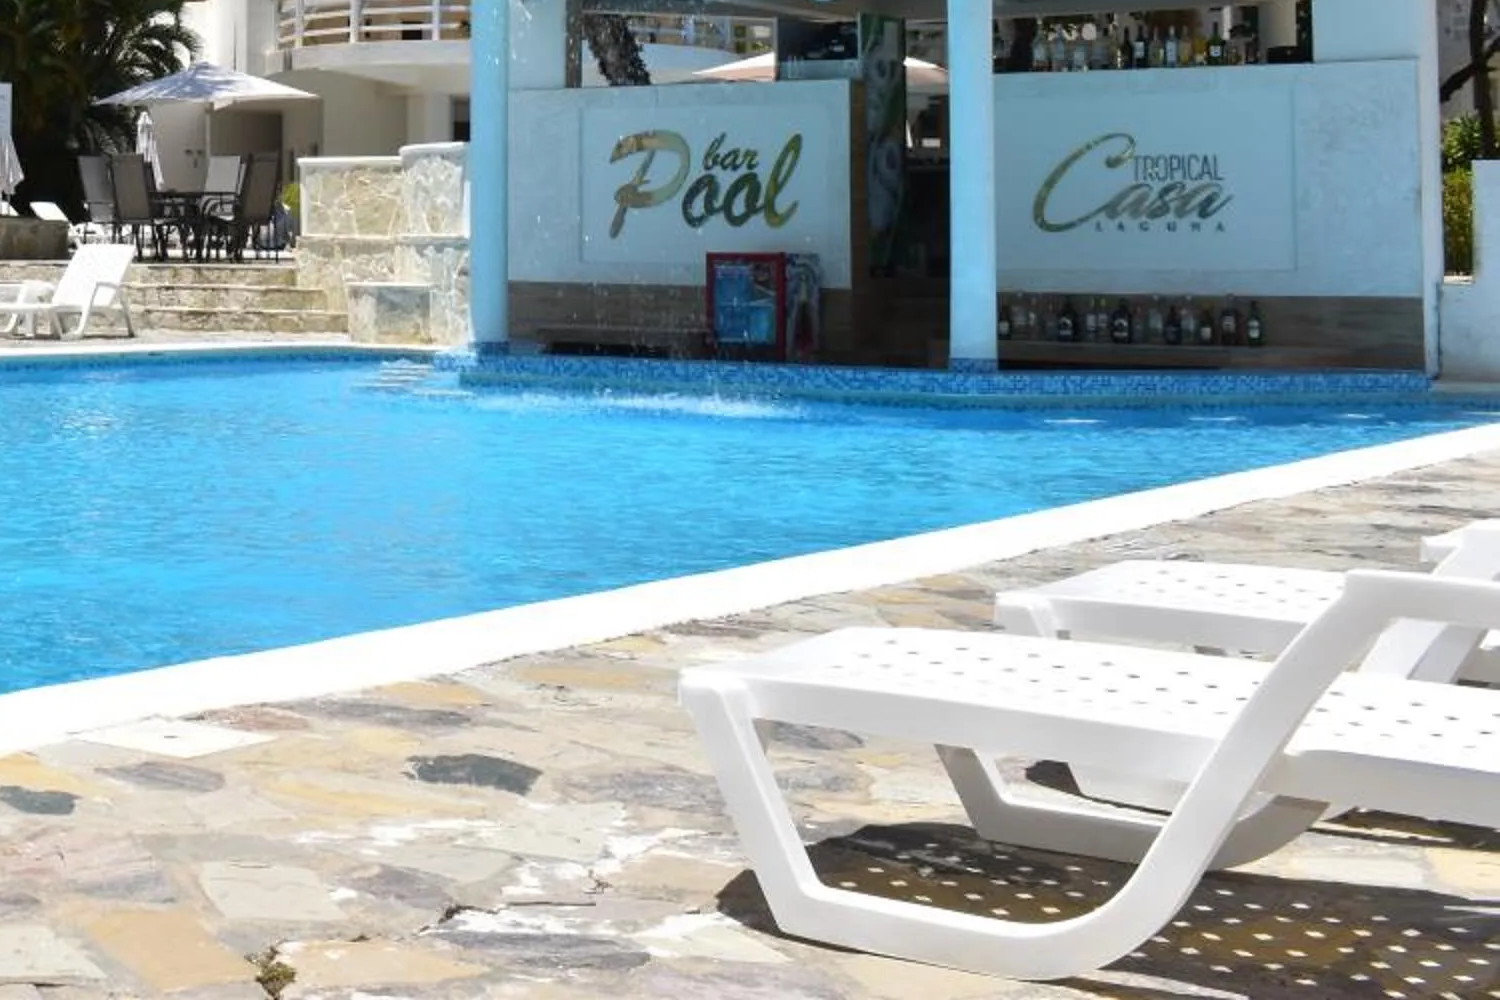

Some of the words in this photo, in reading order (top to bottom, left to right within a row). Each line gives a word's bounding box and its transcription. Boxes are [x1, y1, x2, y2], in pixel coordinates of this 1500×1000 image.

[702, 131, 760, 172] bar
[1132, 154, 1226, 182] TROPICAL
[609, 129, 803, 239] Pool
[1032, 132, 1235, 232] Casa
[1094, 220, 1226, 233] LAGUNA
